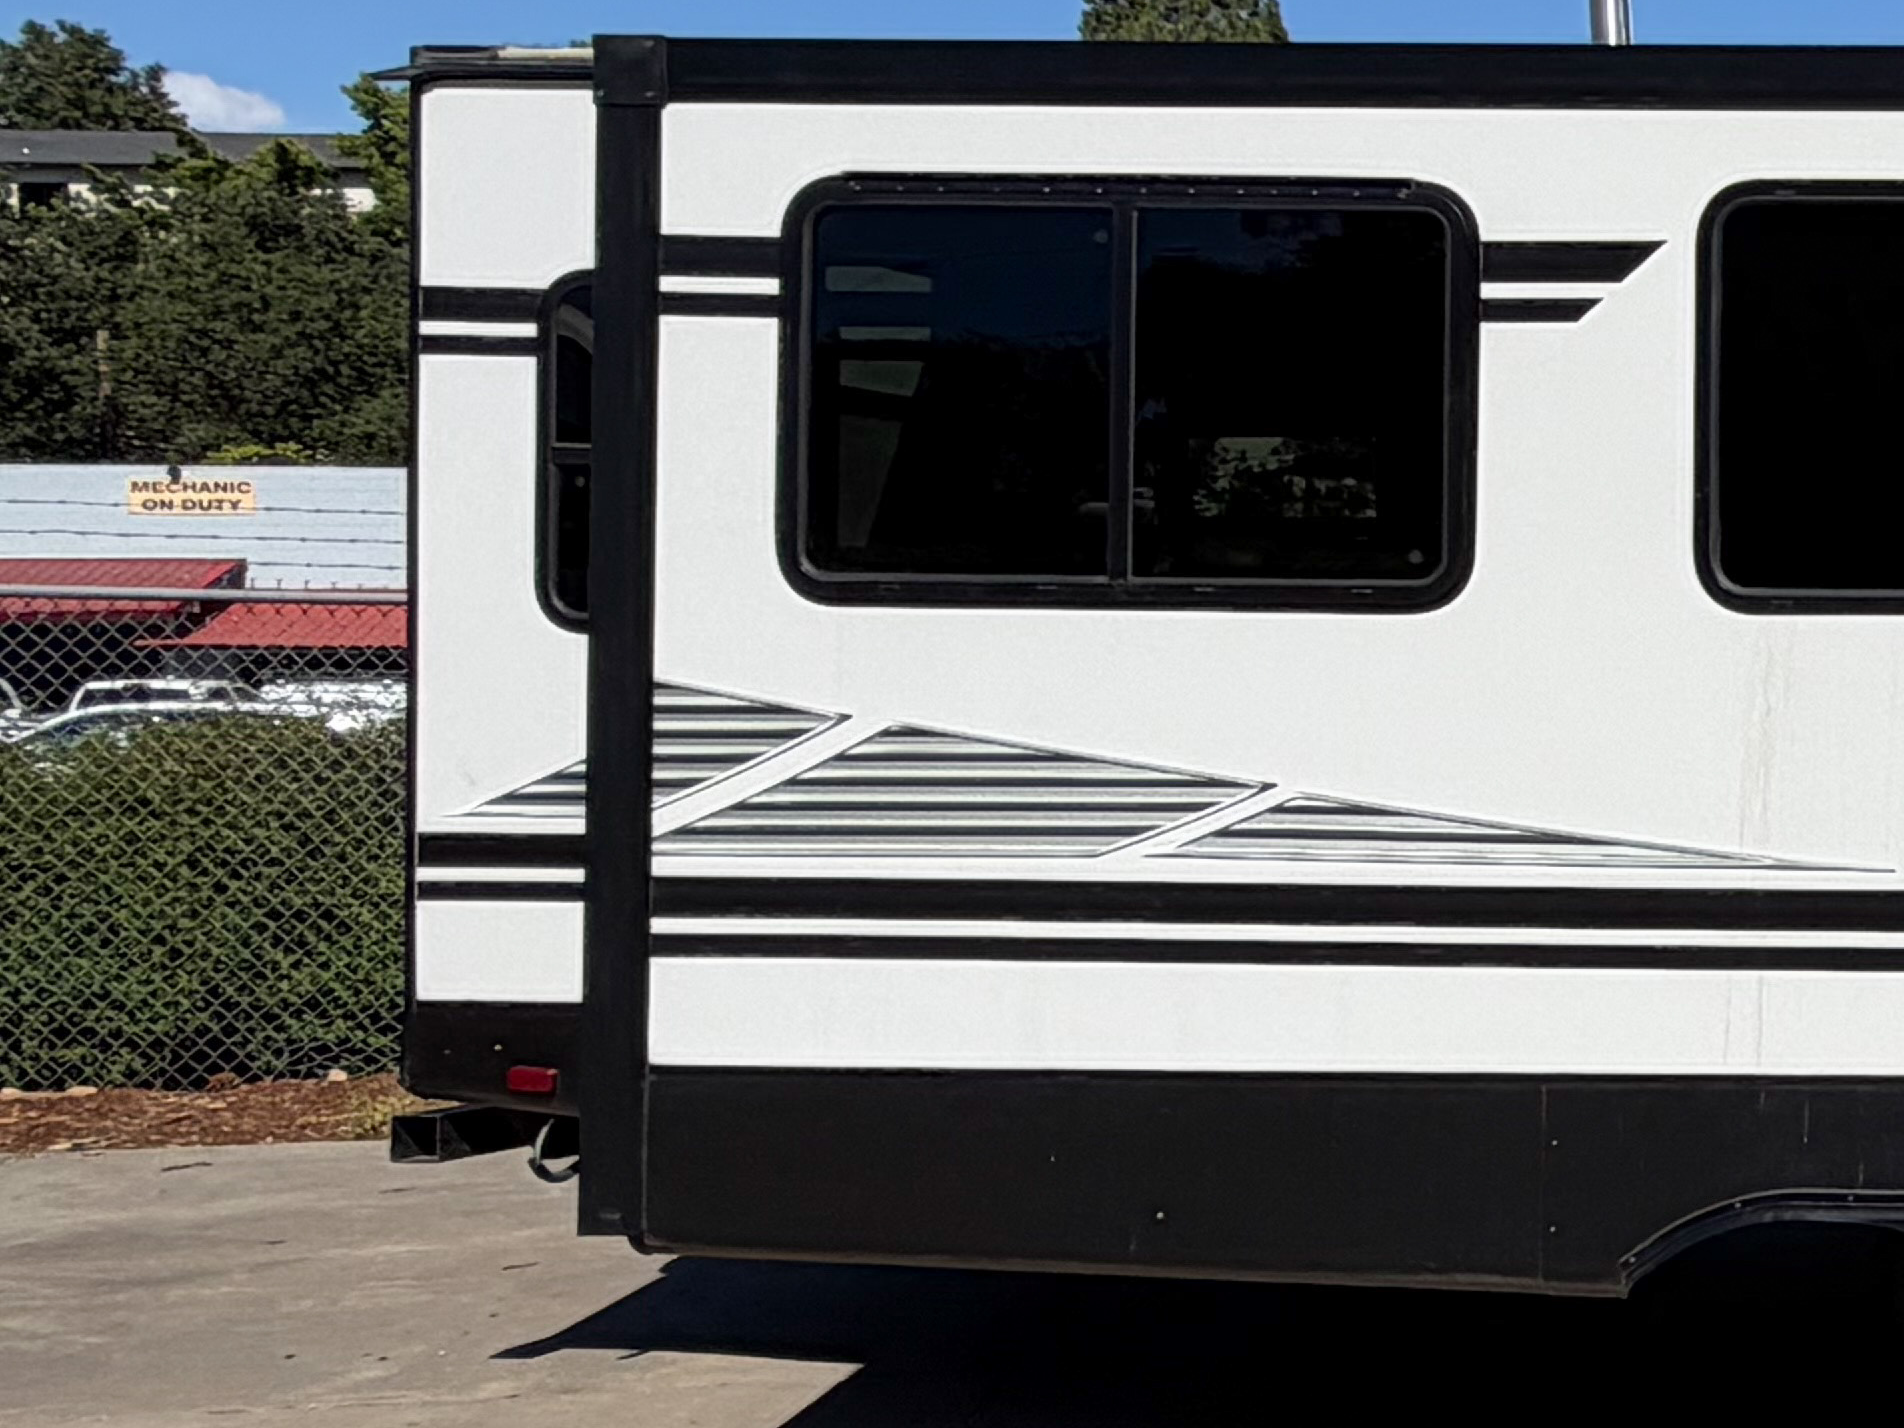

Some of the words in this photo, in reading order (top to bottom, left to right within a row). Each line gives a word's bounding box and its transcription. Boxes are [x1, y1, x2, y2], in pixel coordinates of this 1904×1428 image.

[130, 481, 251, 494] MECHANIC
[141, 498, 174, 511] ON
[181, 498, 242, 511] DUTY
